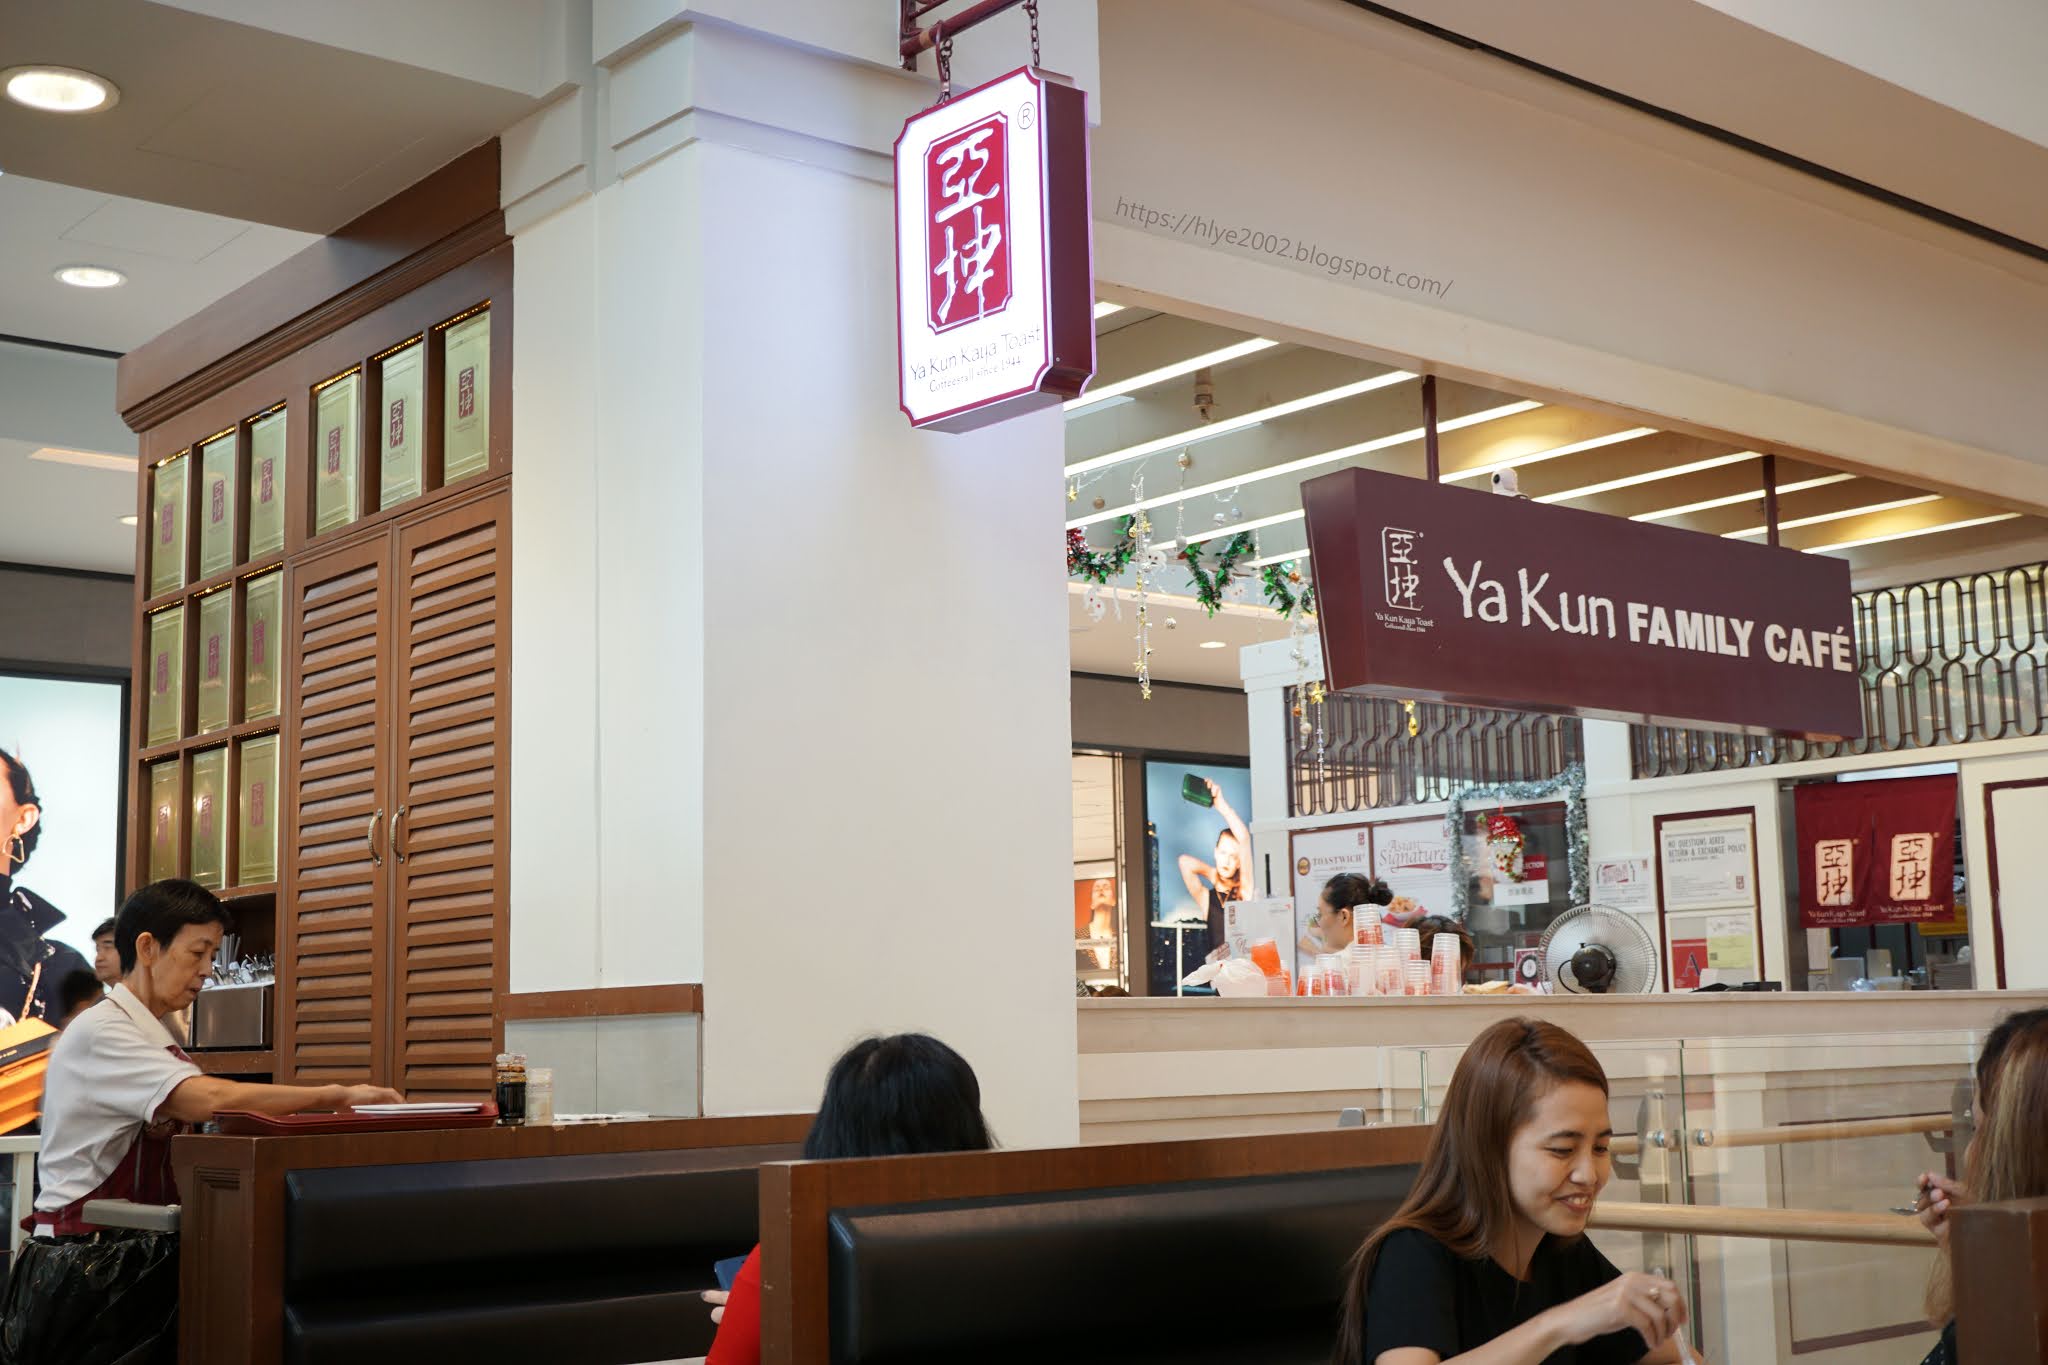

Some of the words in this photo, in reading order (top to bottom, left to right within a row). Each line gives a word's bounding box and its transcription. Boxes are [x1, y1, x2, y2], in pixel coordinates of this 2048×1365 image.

[911, 362, 926, 380] Ya
[930, 355, 957, 375] Kun
[961, 343, 997, 364] Kaya
[1001, 322, 1040, 352] Toast
[1375, 612, 1384, 621] Ya
[1384, 613, 1398, 623] Kun
[1415, 616, 1434, 627] Toast
[1442, 557, 1508, 623] Ya
[1517, 567, 1617, 640] Kun
[1627, 601, 1755, 659] FAMILY
[1764, 625, 1854, 673] CAFÉ
[1668, 839, 1676, 849] NO
[1678, 837, 1707, 848] QUESTIONS
[1698, 845, 1725, 855] EXCHANGE
[1727, 842, 1747, 853] POLICY
[1312, 853, 1362, 867] TOASTWICH
[1682, 951, 1701, 978] A
